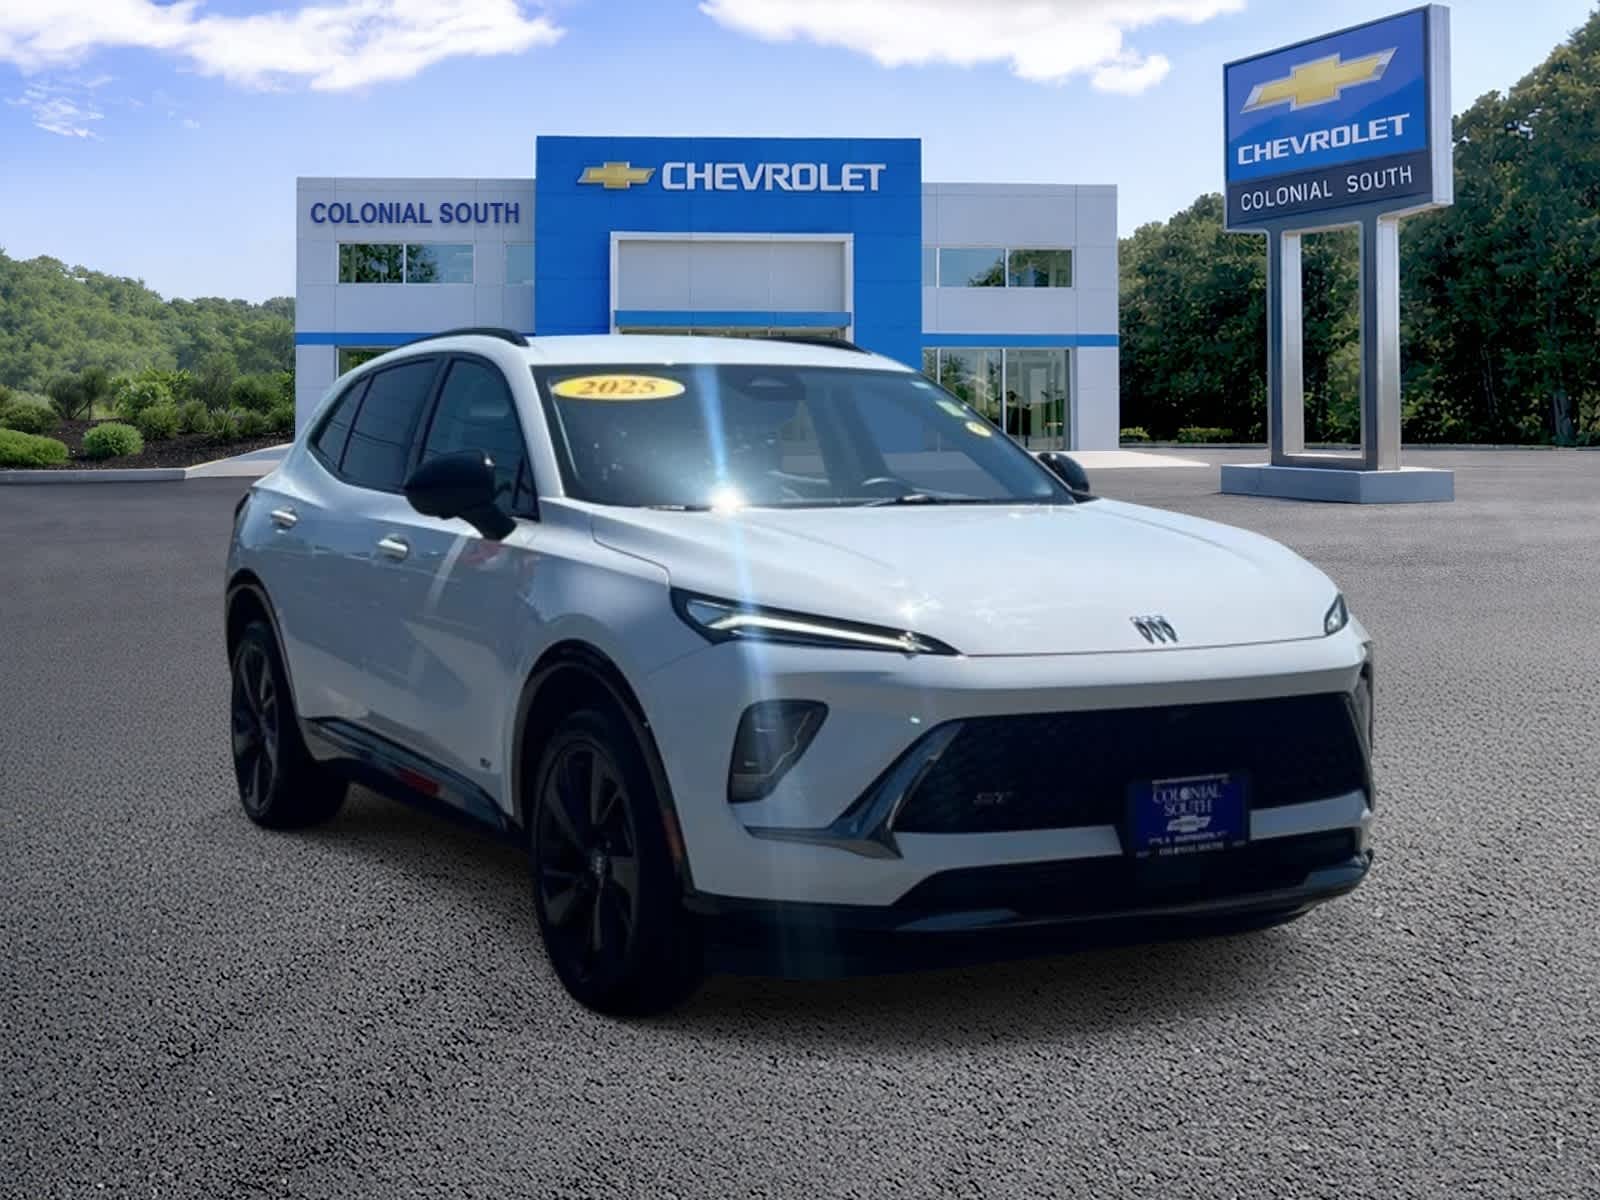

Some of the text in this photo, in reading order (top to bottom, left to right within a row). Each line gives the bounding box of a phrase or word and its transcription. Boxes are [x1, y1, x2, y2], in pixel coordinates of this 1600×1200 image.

[1238, 113, 1410, 165] CHEVROLET
[662, 162, 886, 192] CHEVROLET
[1241, 165, 1412, 211] COLONIAL SOUTH
[310, 202, 520, 224] COLONIAL SOUTH
[577, 380, 658, 395] 2025
[1152, 784, 1223, 804] COLONIAL
[1164, 799, 1213, 816] SOUTH
